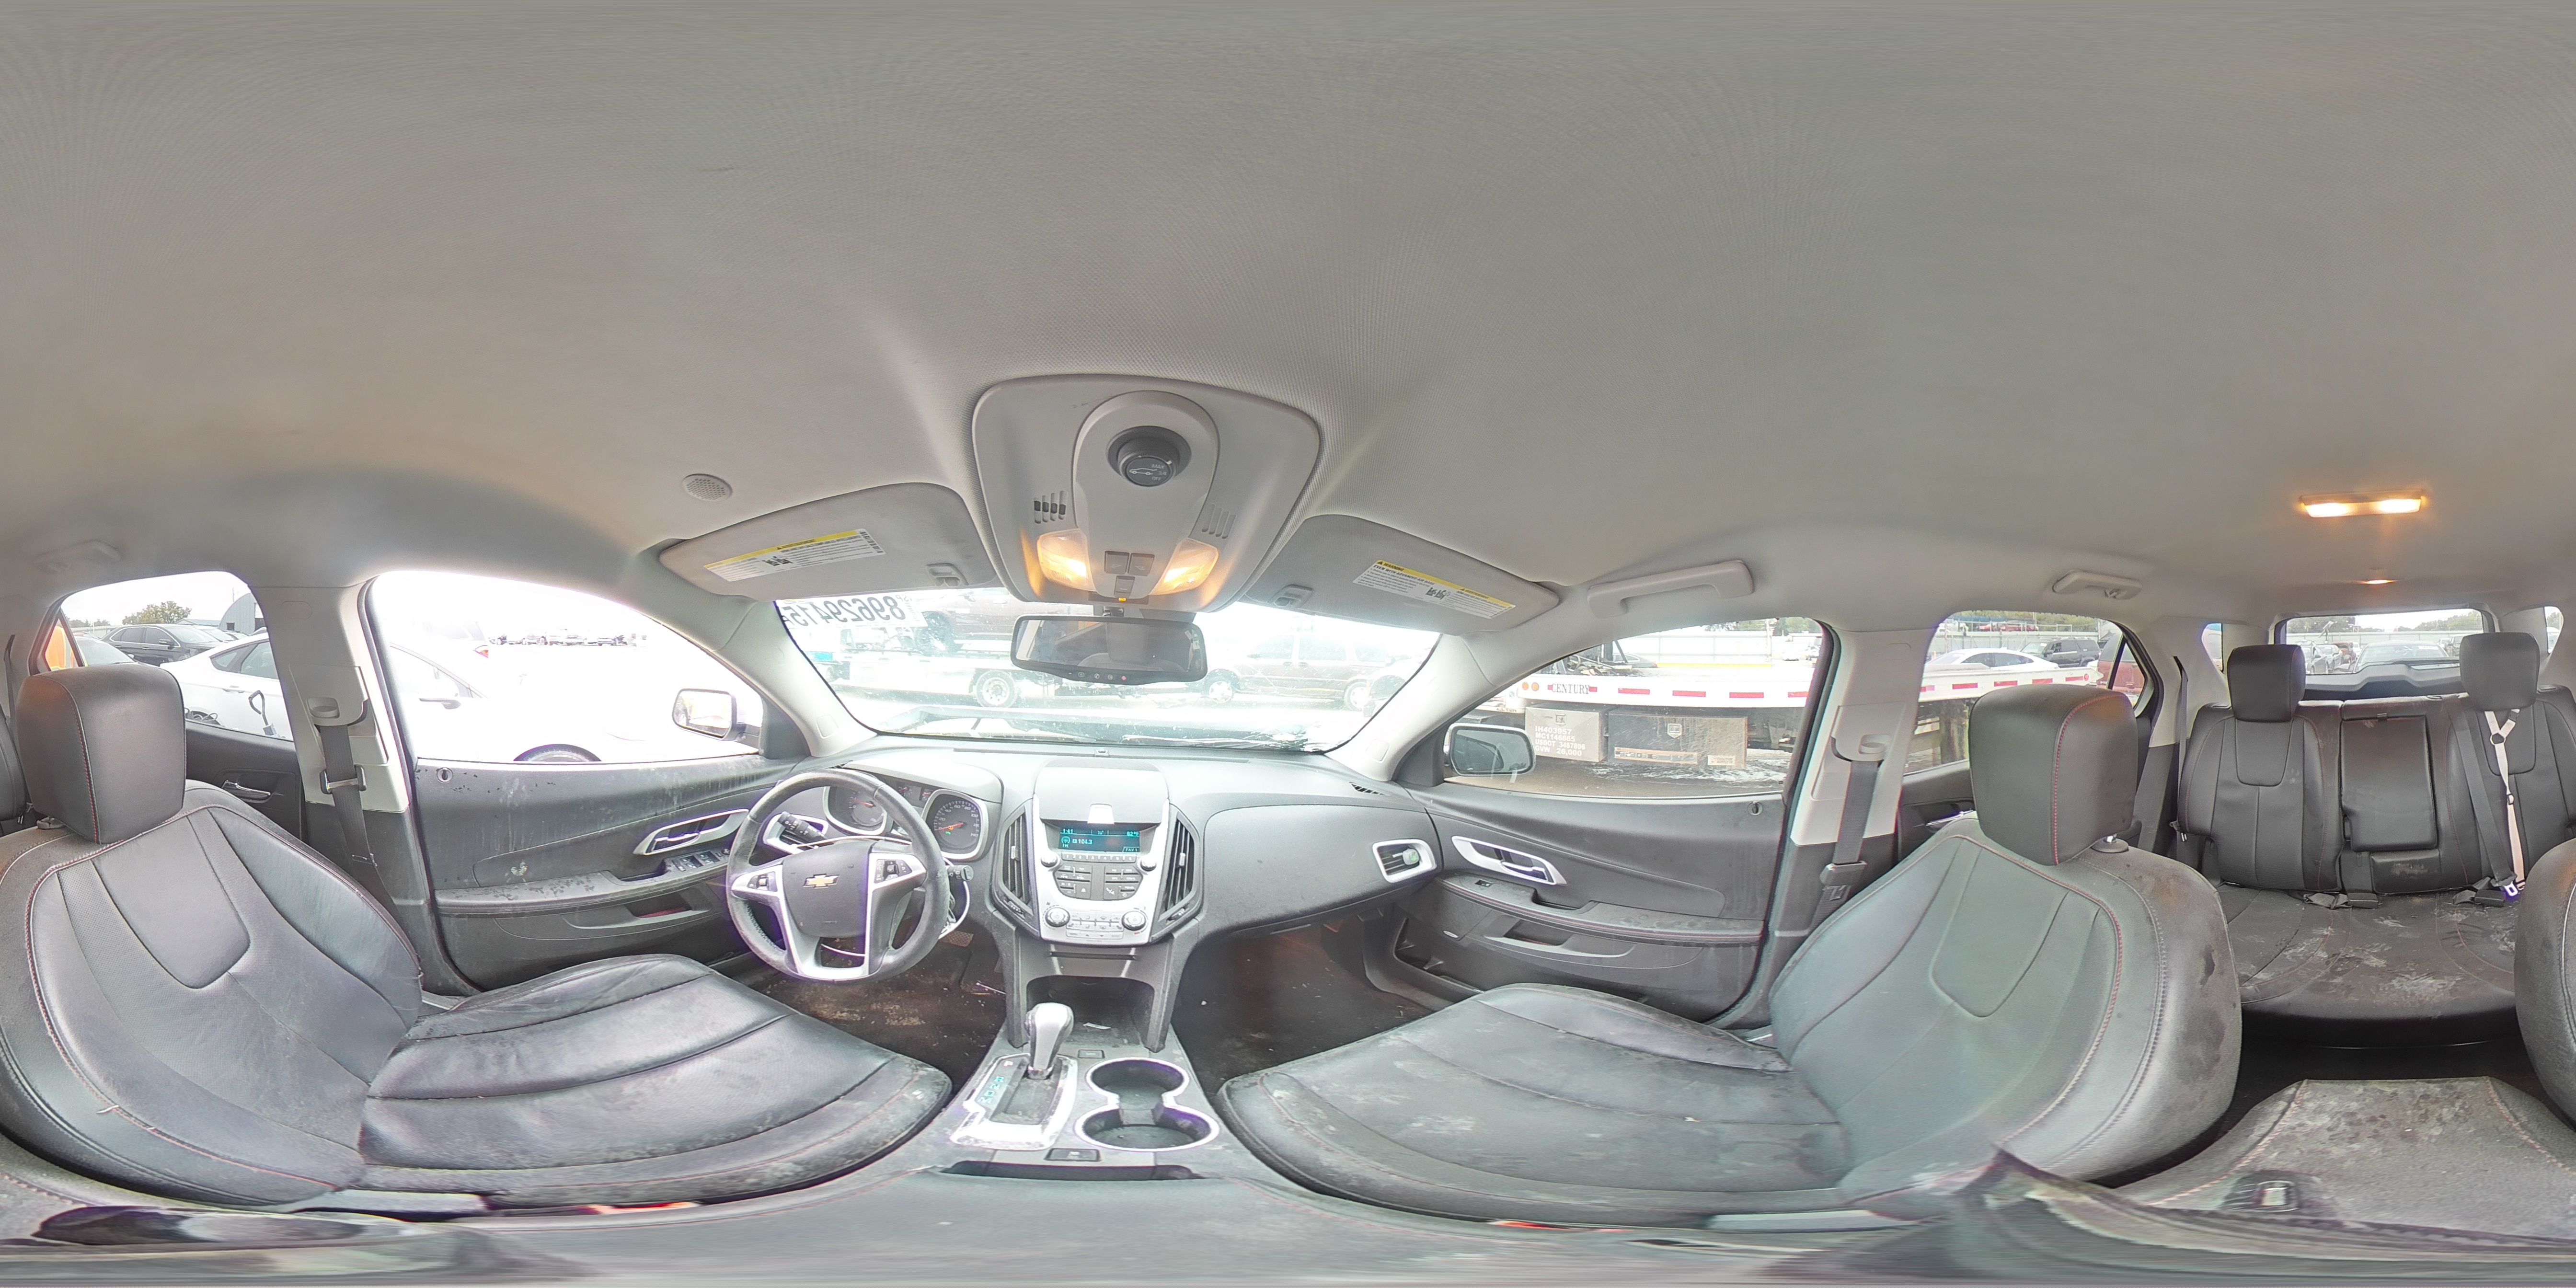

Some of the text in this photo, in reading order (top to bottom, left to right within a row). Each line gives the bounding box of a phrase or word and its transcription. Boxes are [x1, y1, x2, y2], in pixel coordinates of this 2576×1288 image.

[1383, 563, 1404, 572] WARNING
[1396, 571, 1417, 580] ADVANCED
[1552, 683, 1590, 694] CENTURY
[1535, 732, 1576, 742] MC1146865
[1535, 739, 1586, 750] USDOT 3487806
[1556, 748, 1582, 756] 26,000
